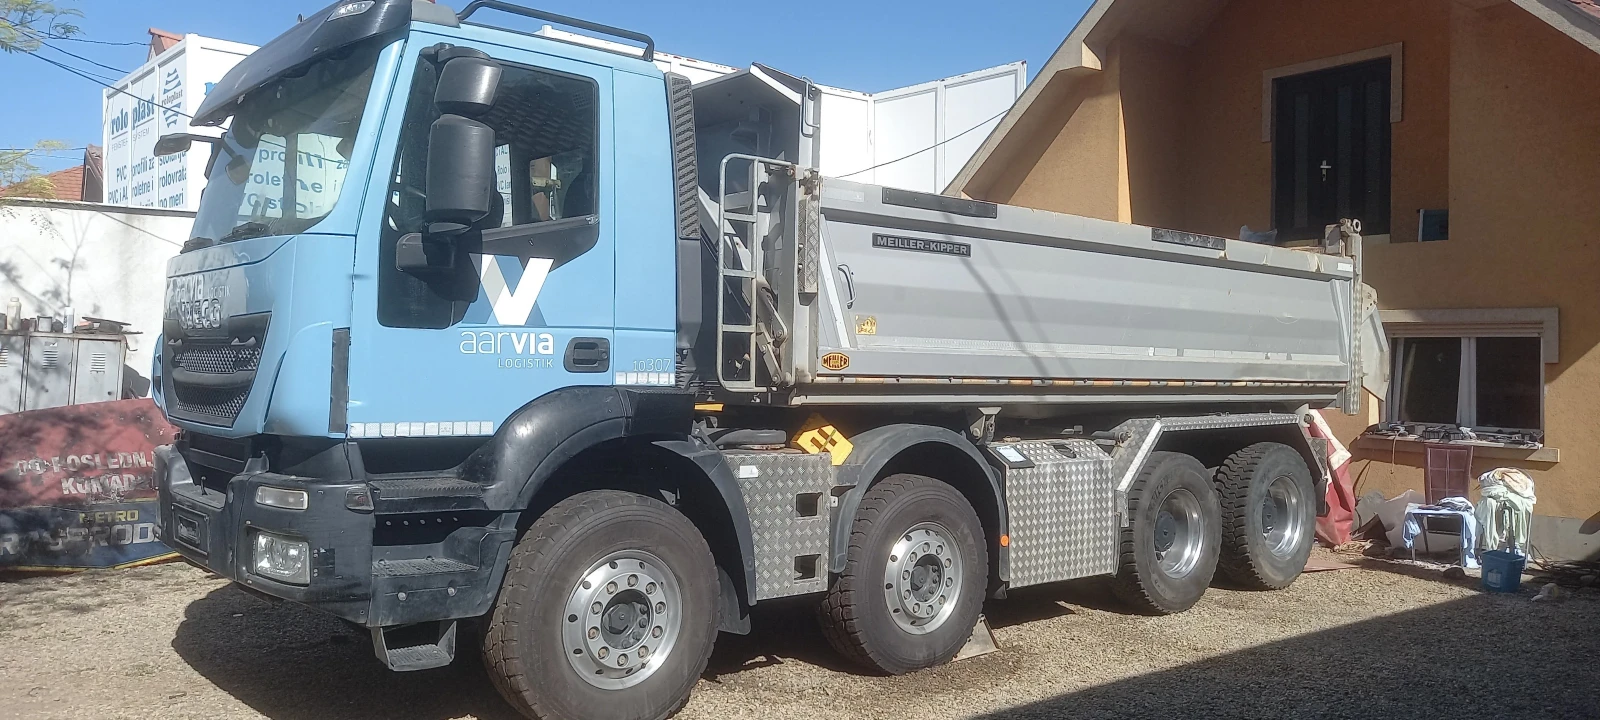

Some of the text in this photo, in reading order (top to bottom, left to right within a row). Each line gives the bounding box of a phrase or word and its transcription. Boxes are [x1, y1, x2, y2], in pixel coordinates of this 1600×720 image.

[111, 93, 155, 135] rolo plast
[116, 165, 127, 183] PVC
[168, 188, 184, 208] meri
[876, 235, 968, 255] MEILLER-KIPPER
[459, 331, 555, 355] aarvia
[498, 358, 554, 369] LOGISTIK
[632, 358, 672, 372] 10307
[822, 354, 849, 369] MEILLER
